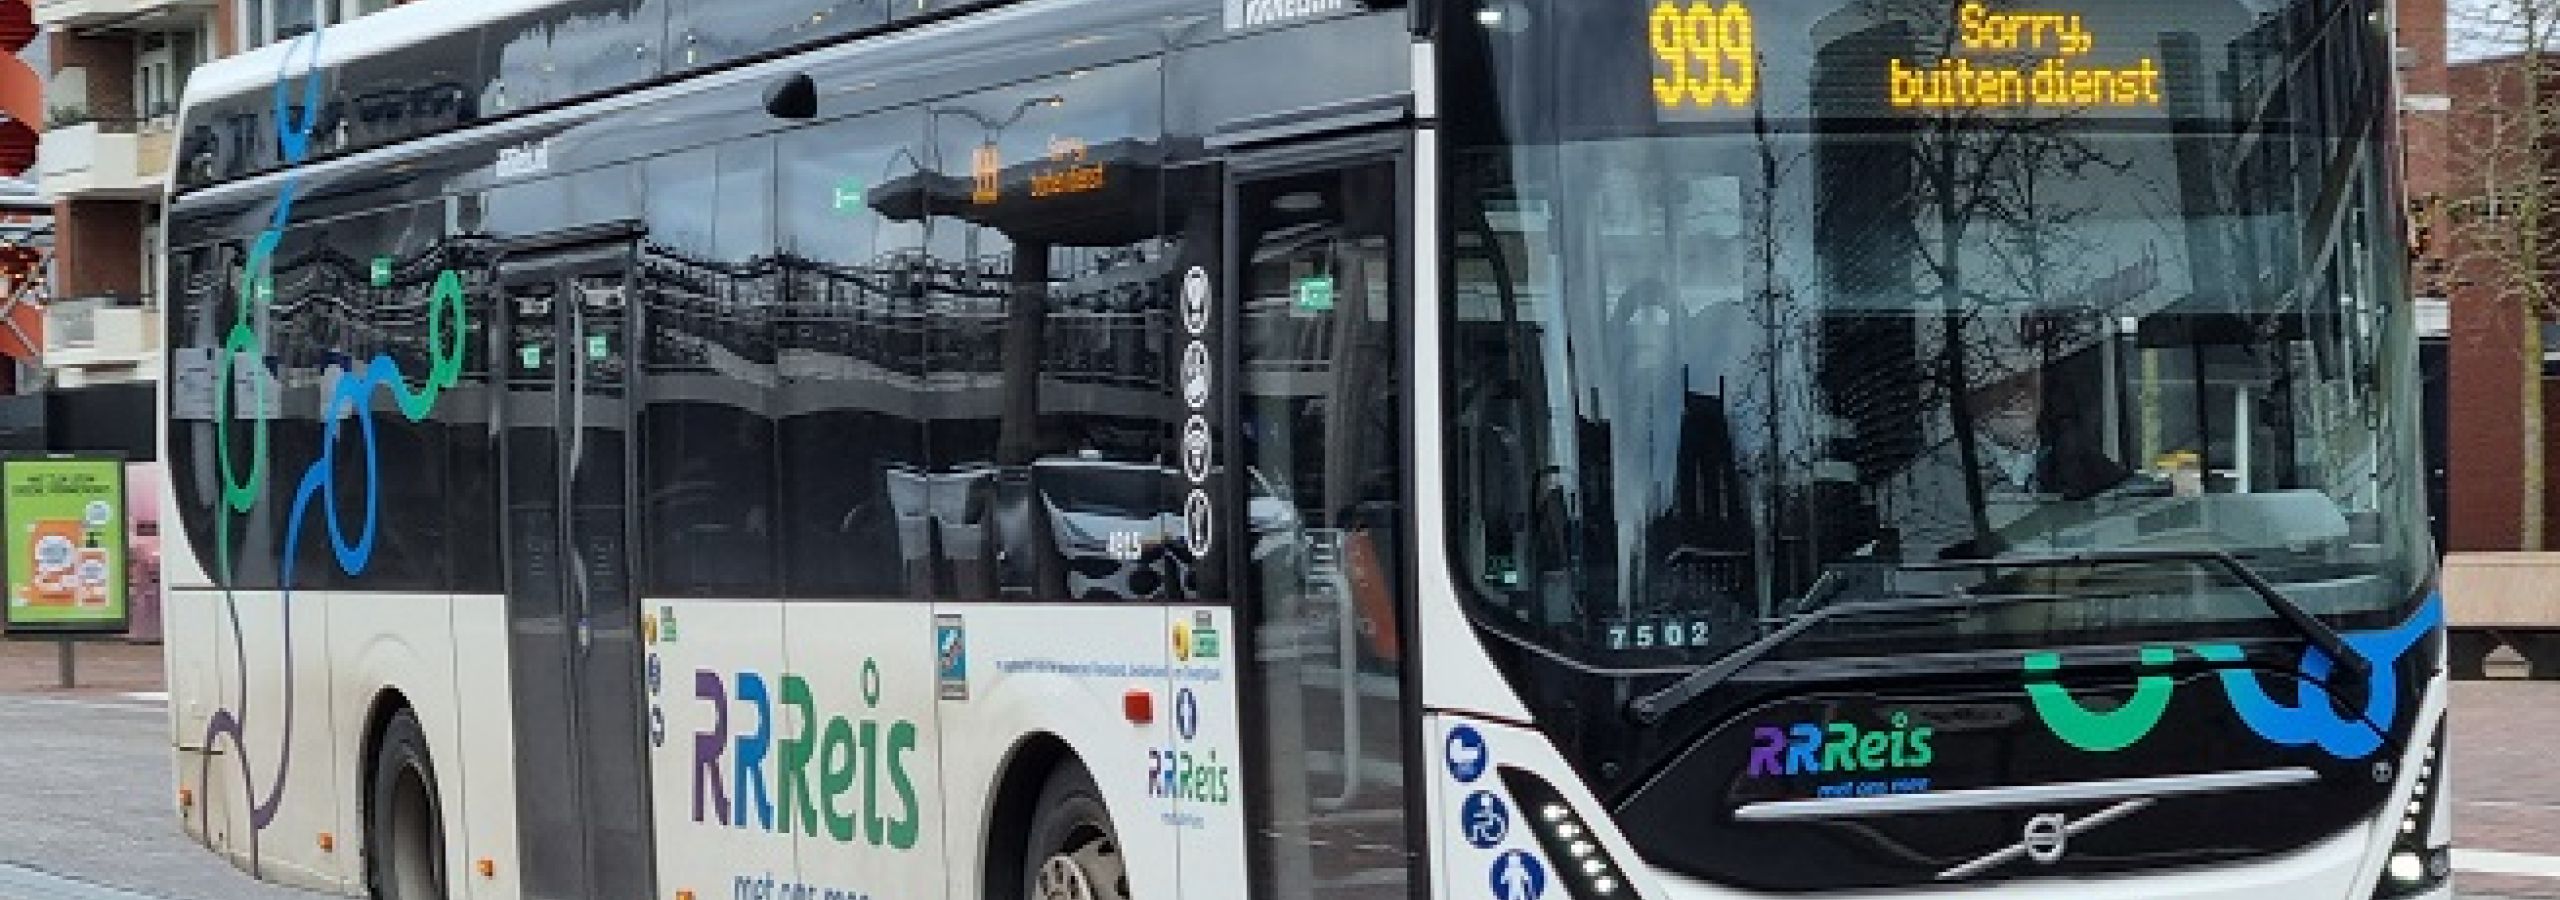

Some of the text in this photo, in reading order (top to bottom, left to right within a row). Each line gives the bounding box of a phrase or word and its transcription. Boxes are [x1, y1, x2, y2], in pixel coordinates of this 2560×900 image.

[1648, 2, 1752, 106] 999
[1961, 3, 2092, 53] Sorry,
[1891, 58, 2159, 103] buiten dienst
[1609, 621, 1709, 650] 7502
[692, 656, 919, 850] RRReis
[1748, 711, 1933, 778] RRReis
[1148, 747, 1229, 804] RRReis
